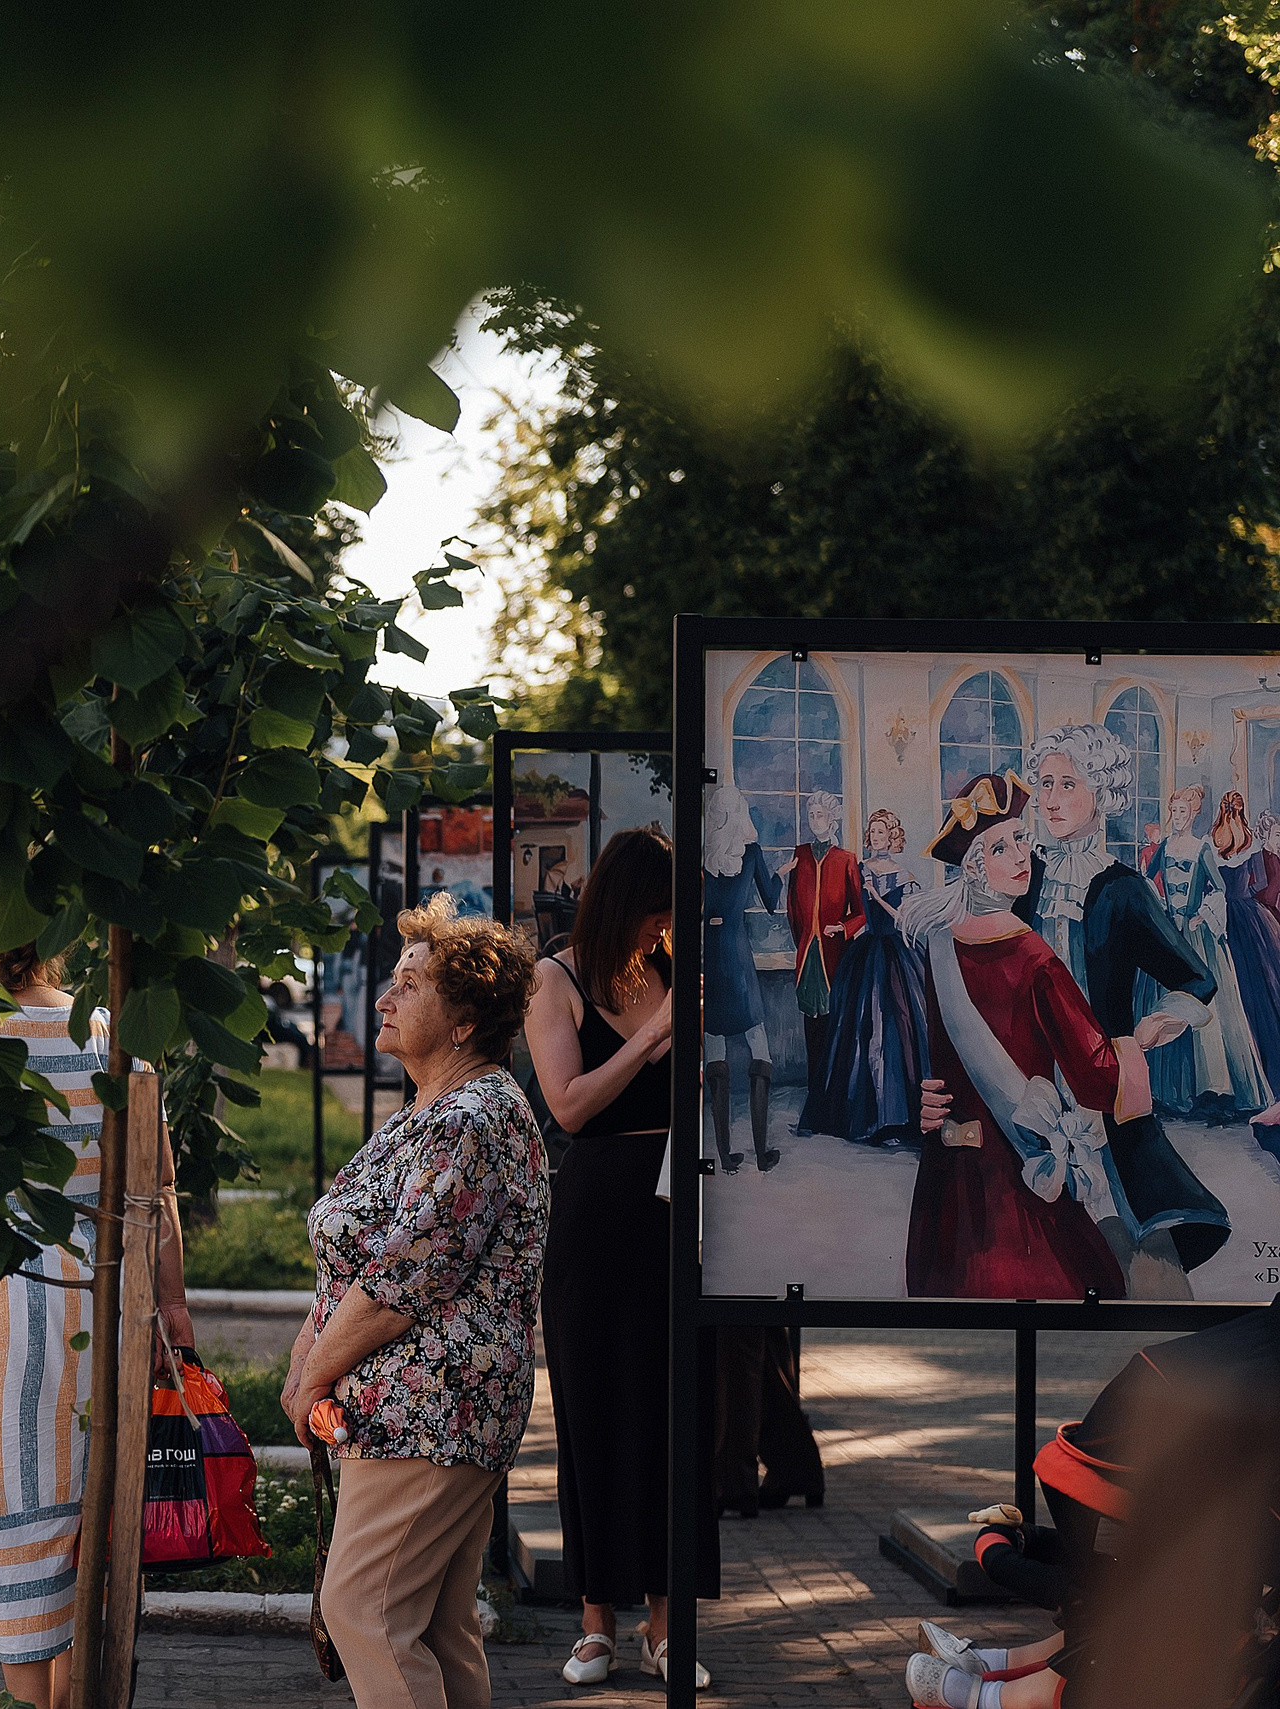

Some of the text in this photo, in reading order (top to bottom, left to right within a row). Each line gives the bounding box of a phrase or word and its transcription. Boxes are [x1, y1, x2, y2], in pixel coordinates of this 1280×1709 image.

[1252, 1241, 1280, 1258] Ух
[147, 1448, 196, 1461] В ГОШ
